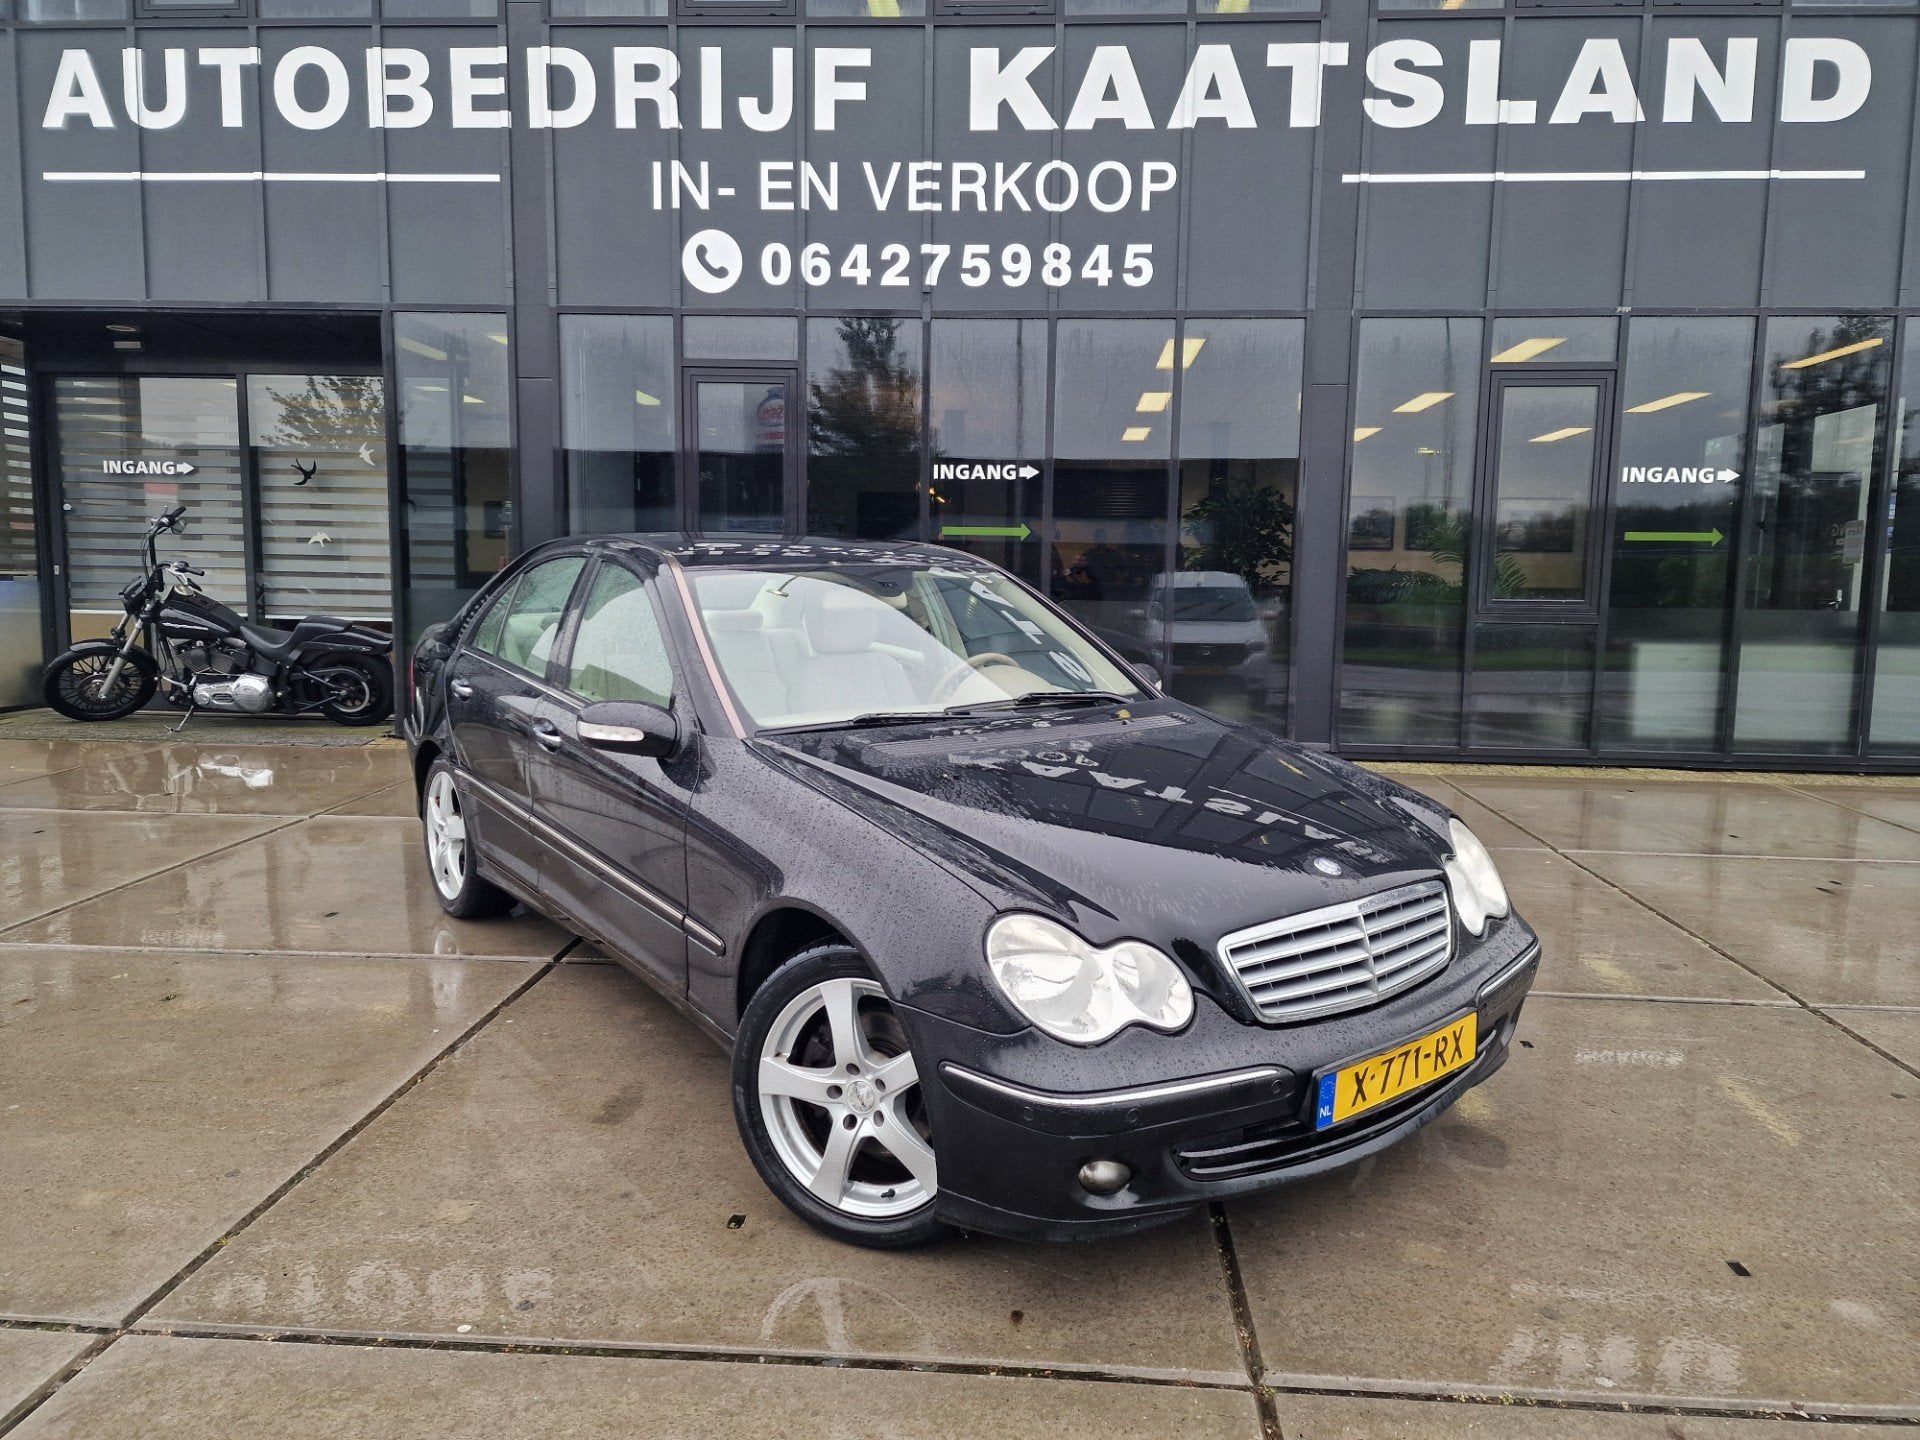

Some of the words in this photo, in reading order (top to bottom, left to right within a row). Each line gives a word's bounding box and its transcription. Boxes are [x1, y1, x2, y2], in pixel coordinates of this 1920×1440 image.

[42, 45, 872, 132] AUTOBEDRIJF
[969, 37, 1872, 131] KAATSLAND
[651, 160, 736, 210] IN-
[760, 160, 839, 211] EN
[862, 159, 1178, 213] VERKOOP
[761, 242, 1155, 288] 0642759845
[102, 460, 175, 475] INGANG
[933, 464, 1017, 480] INGANG
[1621, 466, 1715, 484] INGANG
[1319, 1105, 1332, 1119] NL
[1351, 1025, 1464, 1108] X-771-RX
